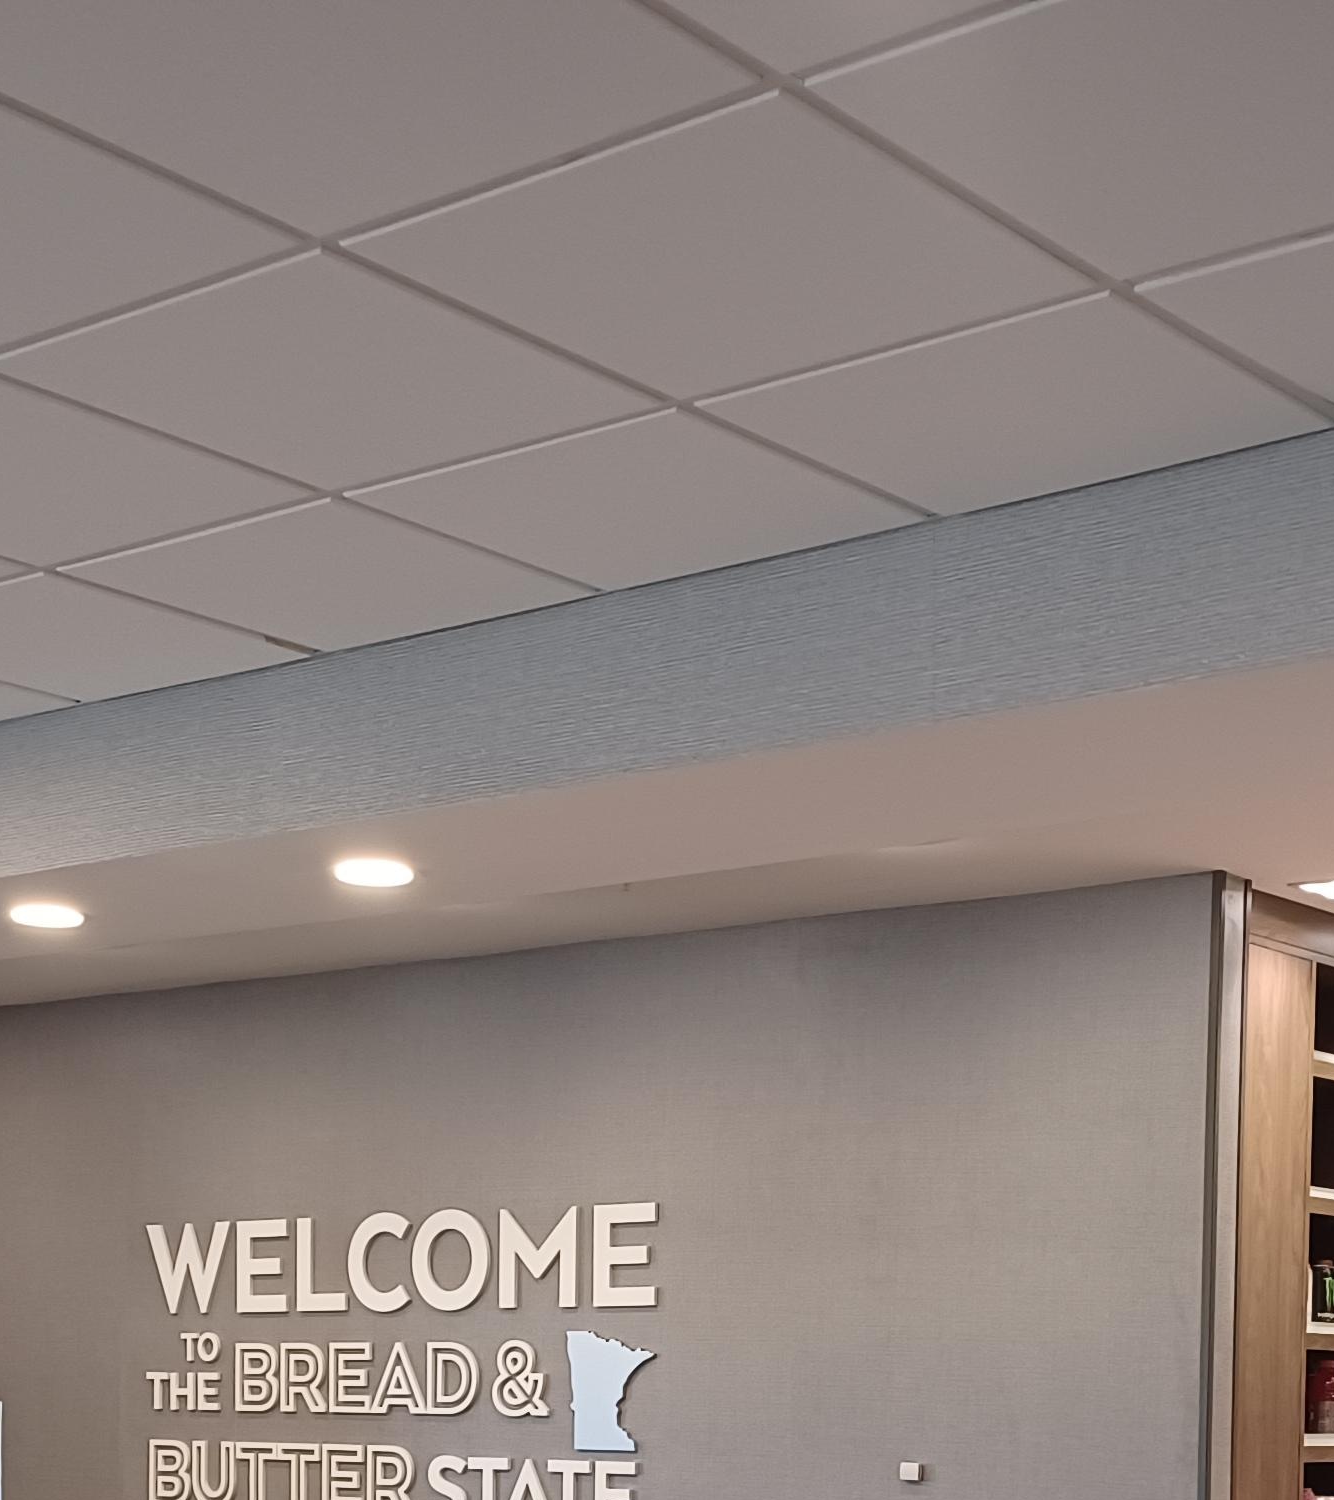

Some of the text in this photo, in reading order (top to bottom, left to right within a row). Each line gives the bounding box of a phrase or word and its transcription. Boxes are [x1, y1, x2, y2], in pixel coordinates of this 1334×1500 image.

[145, 1201, 659, 1315] WELCOME
[145, 1339, 551, 1418] THE BREAD &
[180, 1332, 221, 1363] TO
